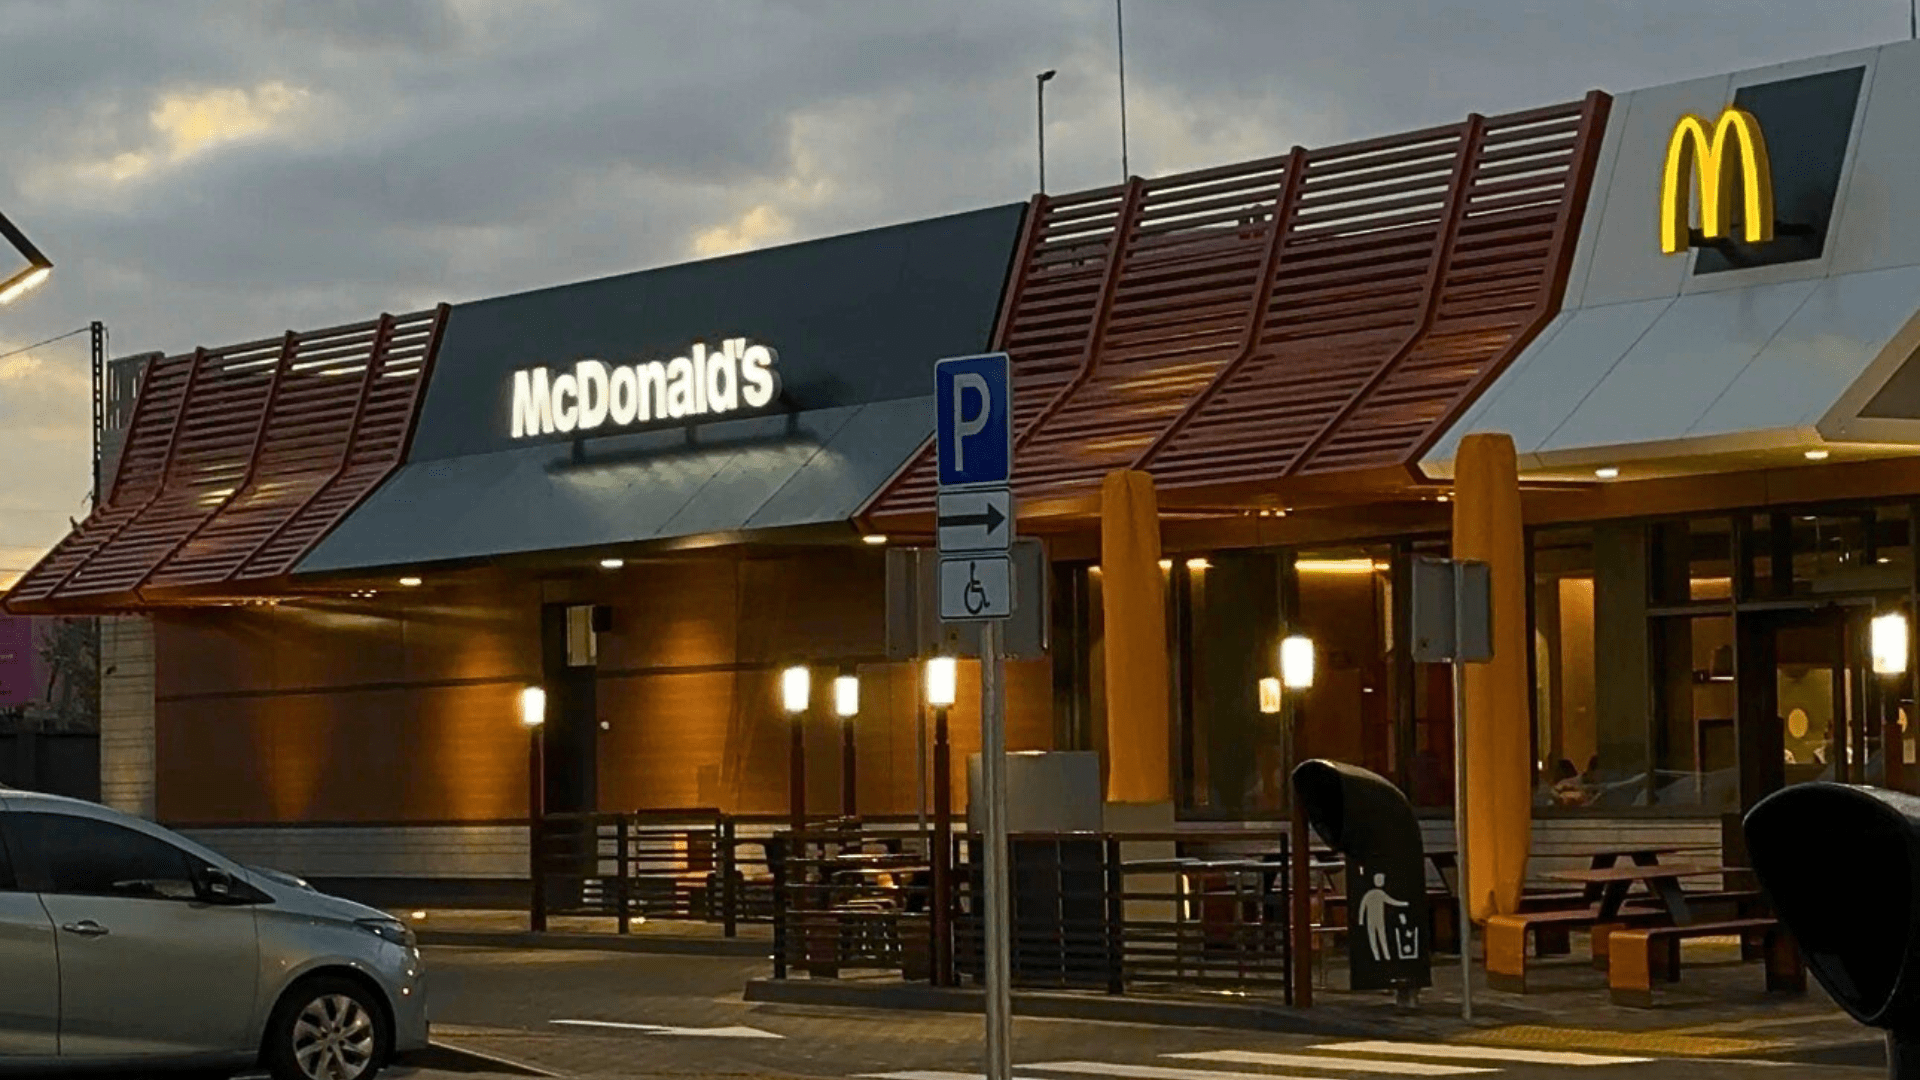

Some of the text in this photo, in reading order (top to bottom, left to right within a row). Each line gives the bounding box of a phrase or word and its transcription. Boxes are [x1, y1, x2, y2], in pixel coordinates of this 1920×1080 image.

[1661, 109, 1768, 253] M
[511, 337, 775, 438] McDonald's
[953, 372, 991, 472] P
